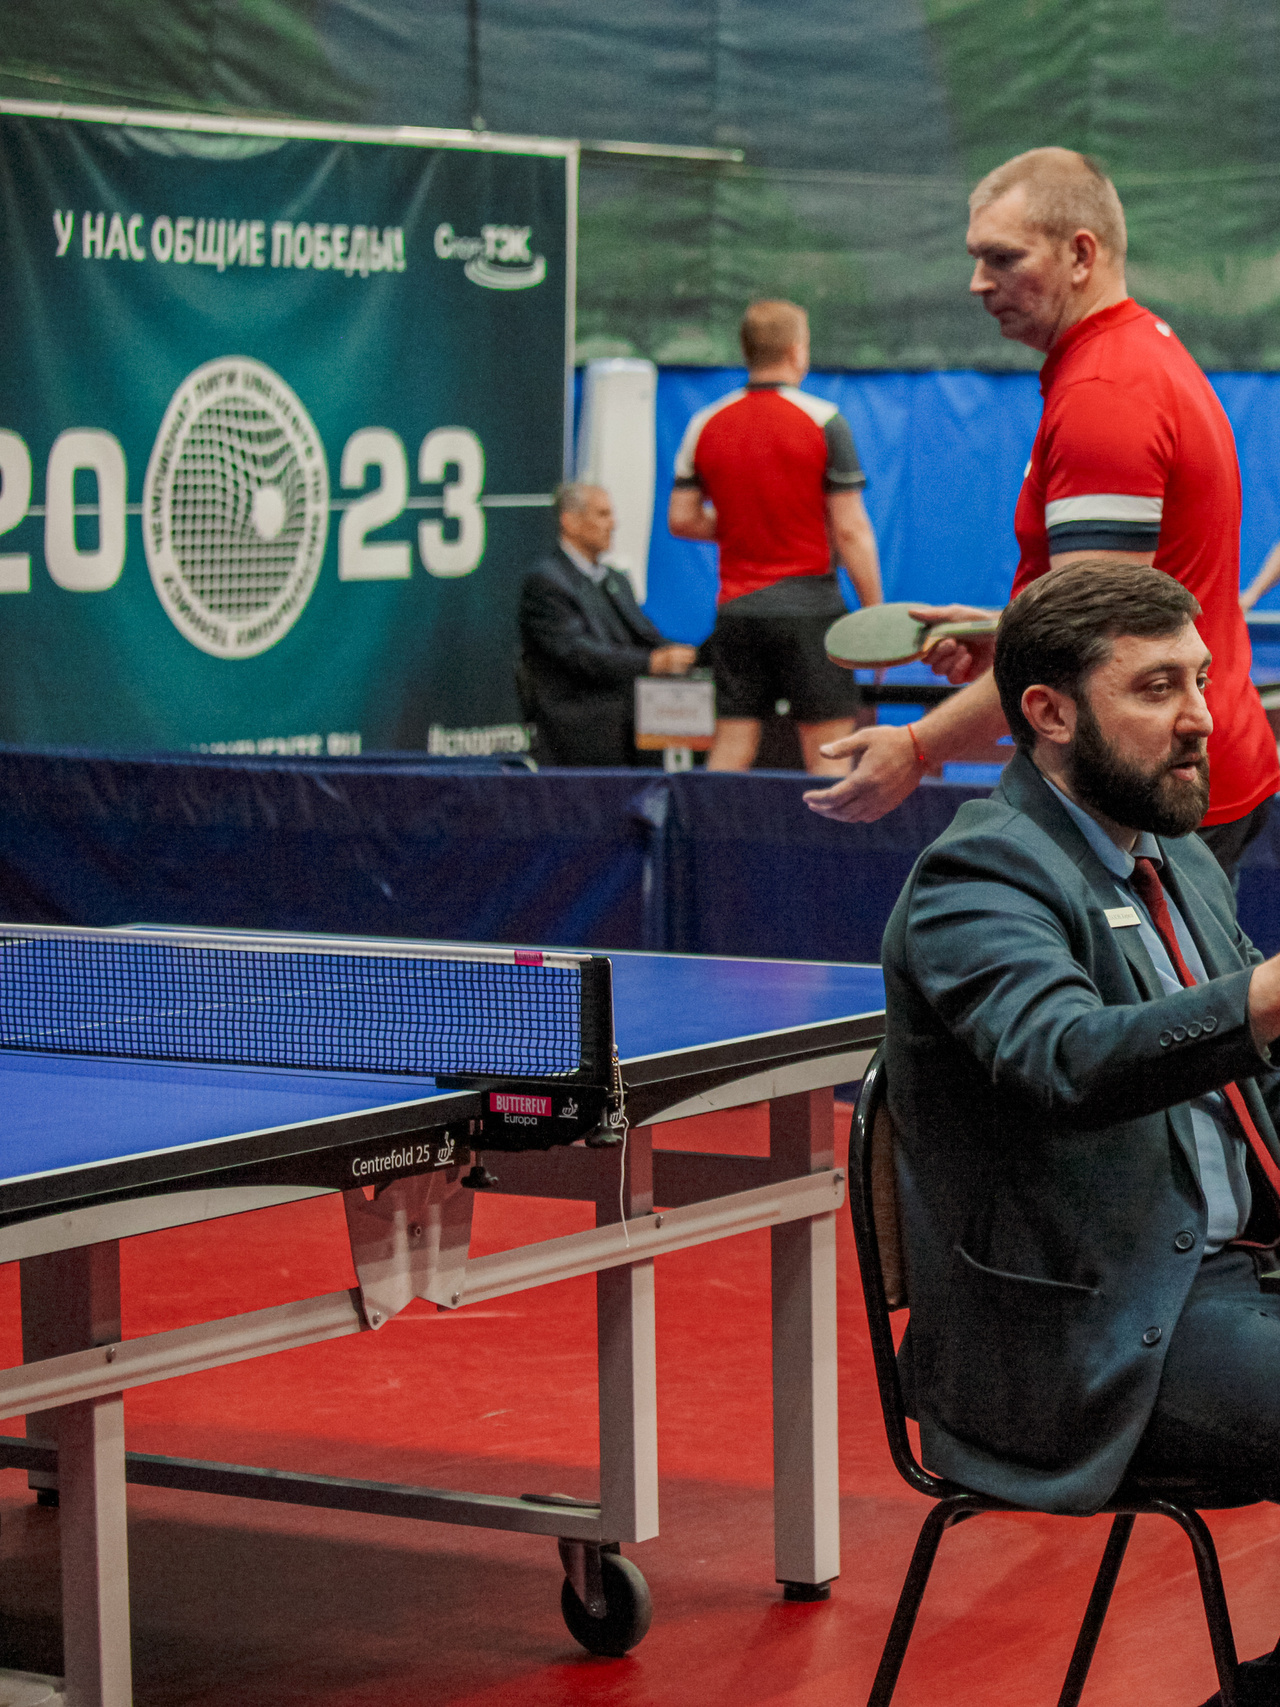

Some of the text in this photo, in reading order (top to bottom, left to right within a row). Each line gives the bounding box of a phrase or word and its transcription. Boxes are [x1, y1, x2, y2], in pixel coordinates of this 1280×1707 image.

[53, 209, 407, 278] У НАС ОБЩИЕ ПОБЕДЫ!
[338, 425, 485, 582] 23
[496, 1095, 547, 1114] BUTTERFLY
[504, 1113, 538, 1126] Europa
[352, 1144, 430, 1177] Centrefold 25
